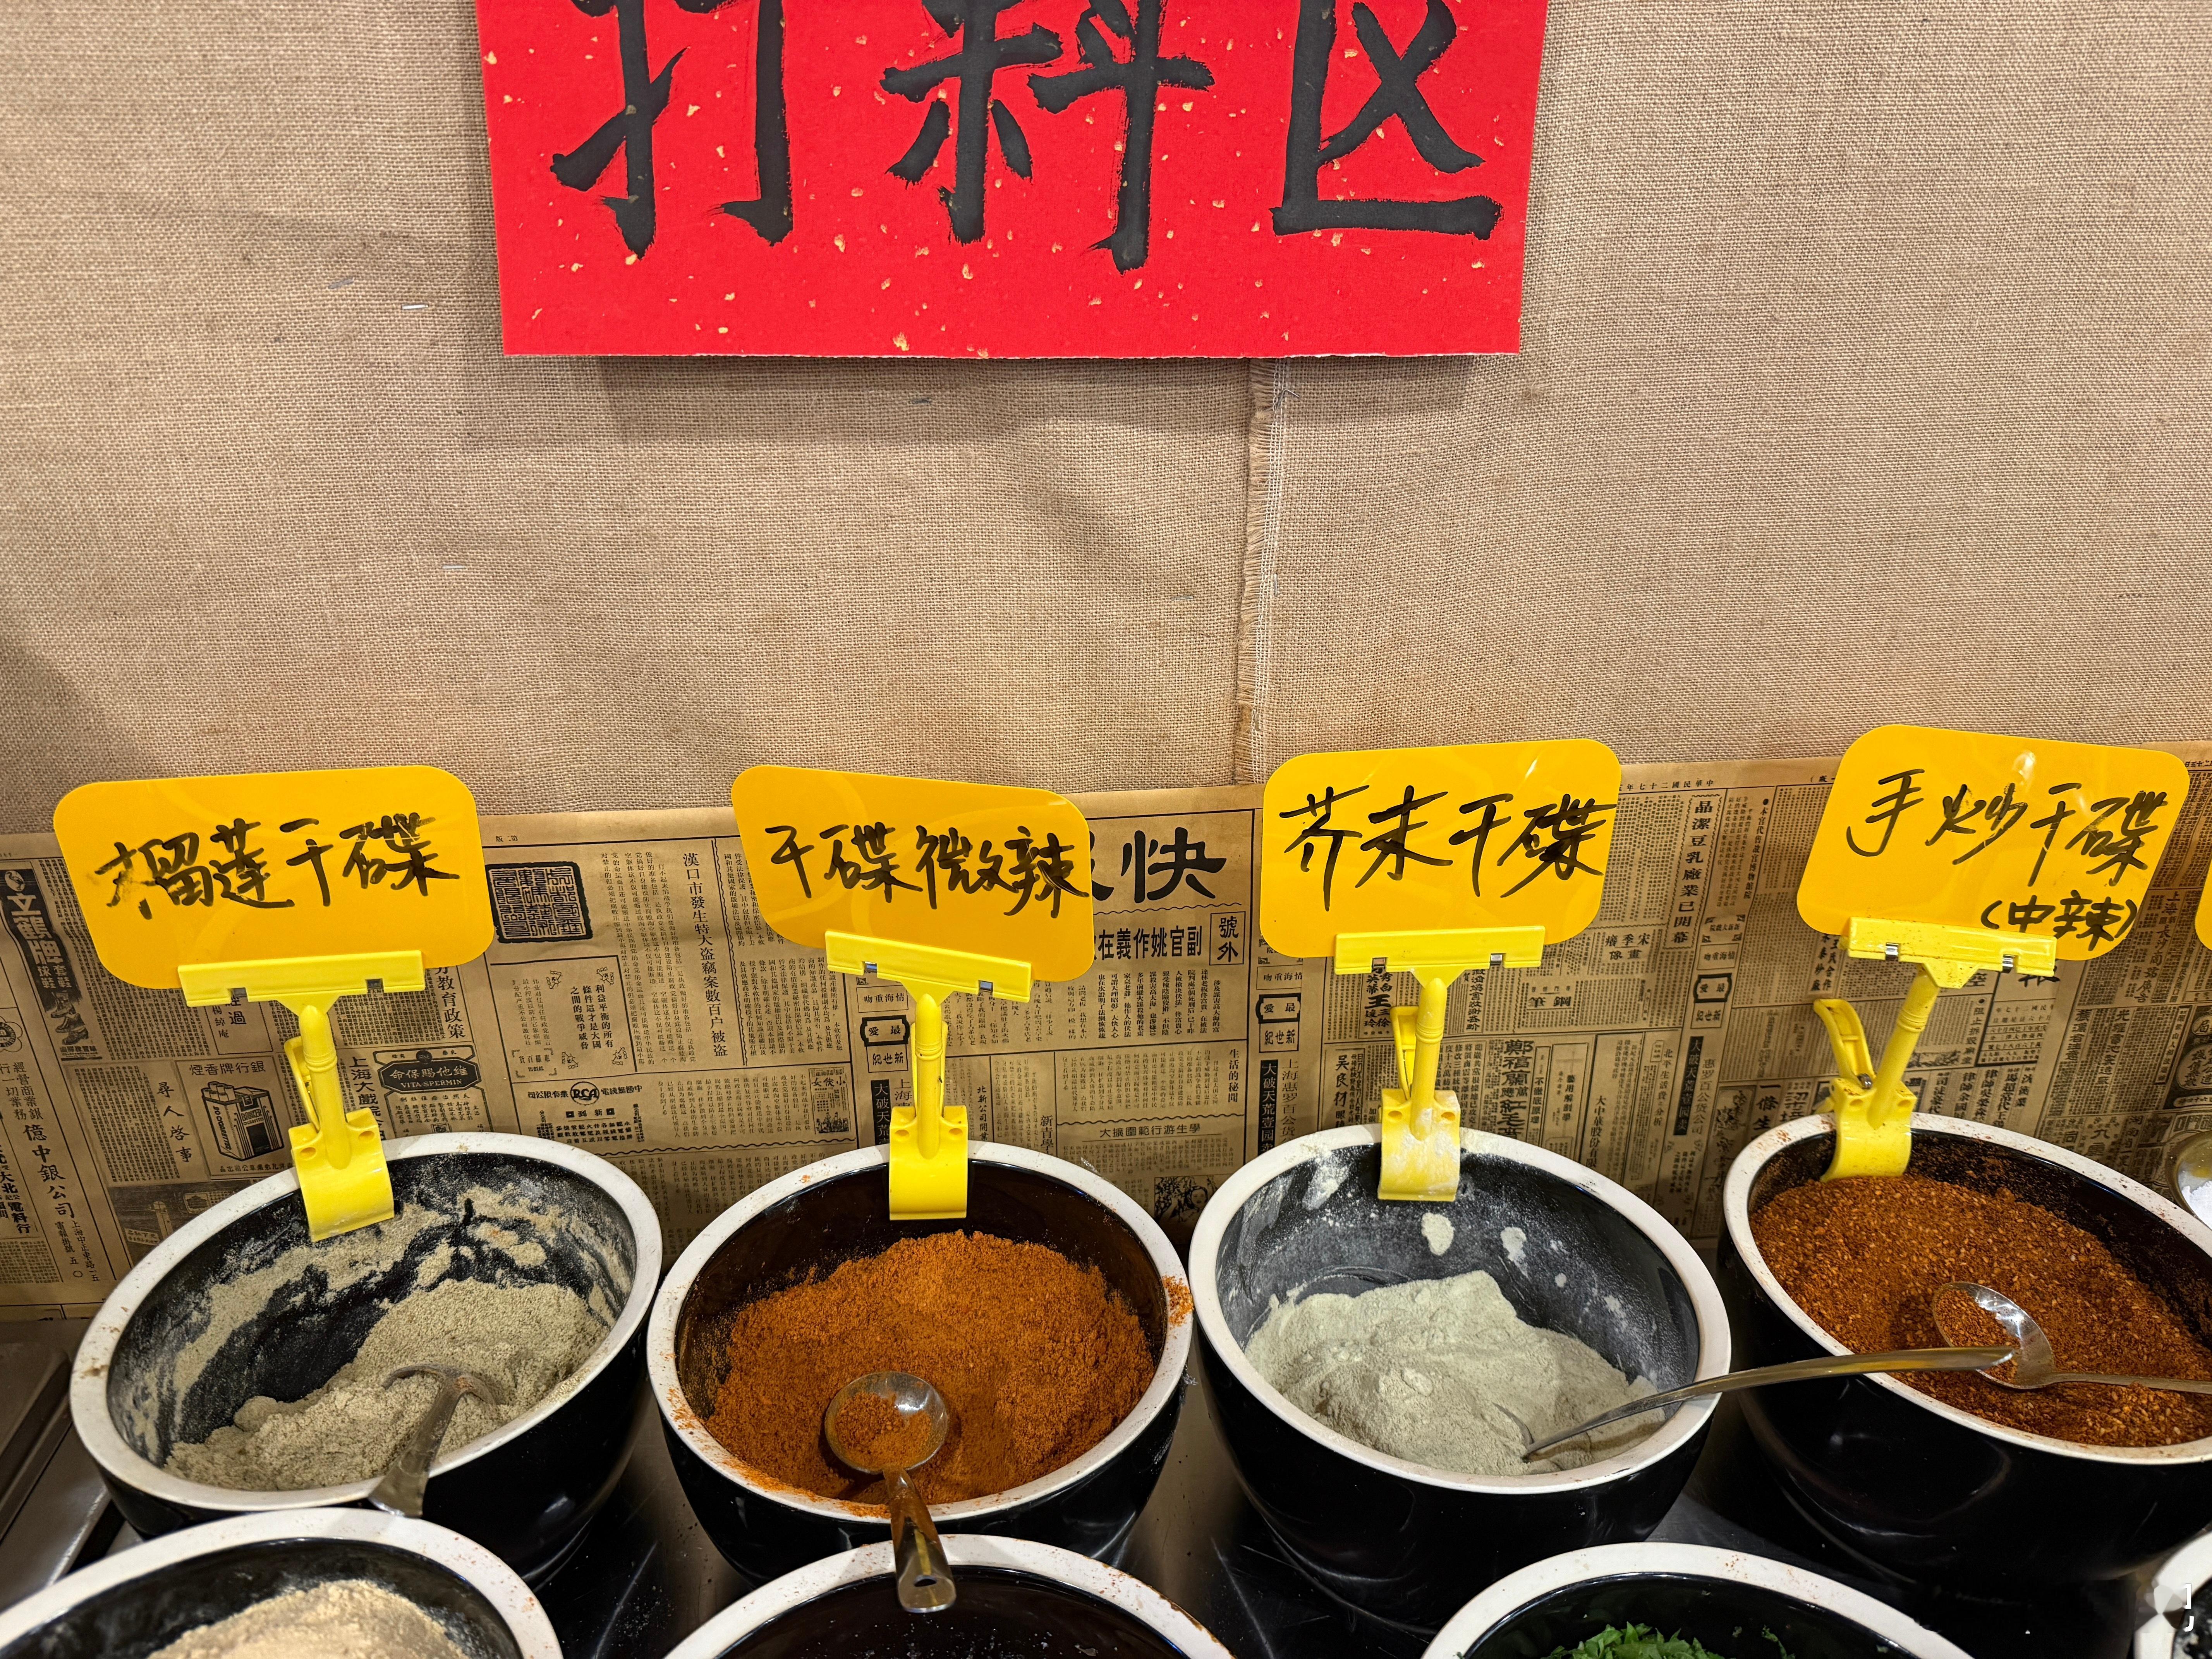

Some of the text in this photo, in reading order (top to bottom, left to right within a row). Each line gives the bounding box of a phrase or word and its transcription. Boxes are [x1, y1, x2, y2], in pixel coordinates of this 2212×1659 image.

[1279, 785, 1617, 912] 芥末干碟
[1094, 924, 1202, 960] 副官姚作義在
[1218, 915, 1239, 962] 號外
